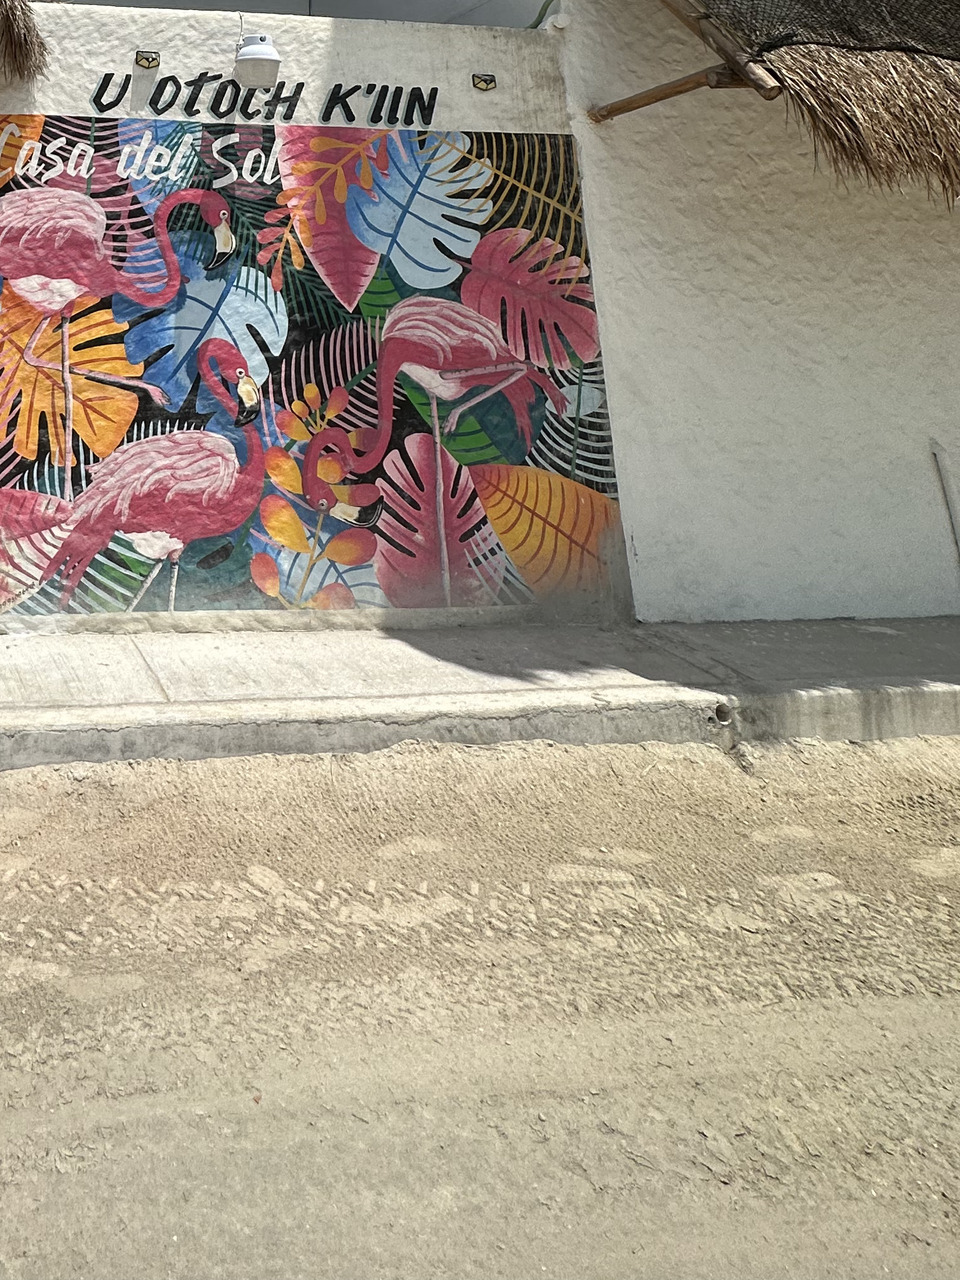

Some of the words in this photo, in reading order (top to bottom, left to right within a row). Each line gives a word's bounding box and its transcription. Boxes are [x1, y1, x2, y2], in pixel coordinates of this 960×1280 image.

[91, 72, 132, 114] U
[116, 129, 194, 181] del
[212, 132, 284, 189] Sol
